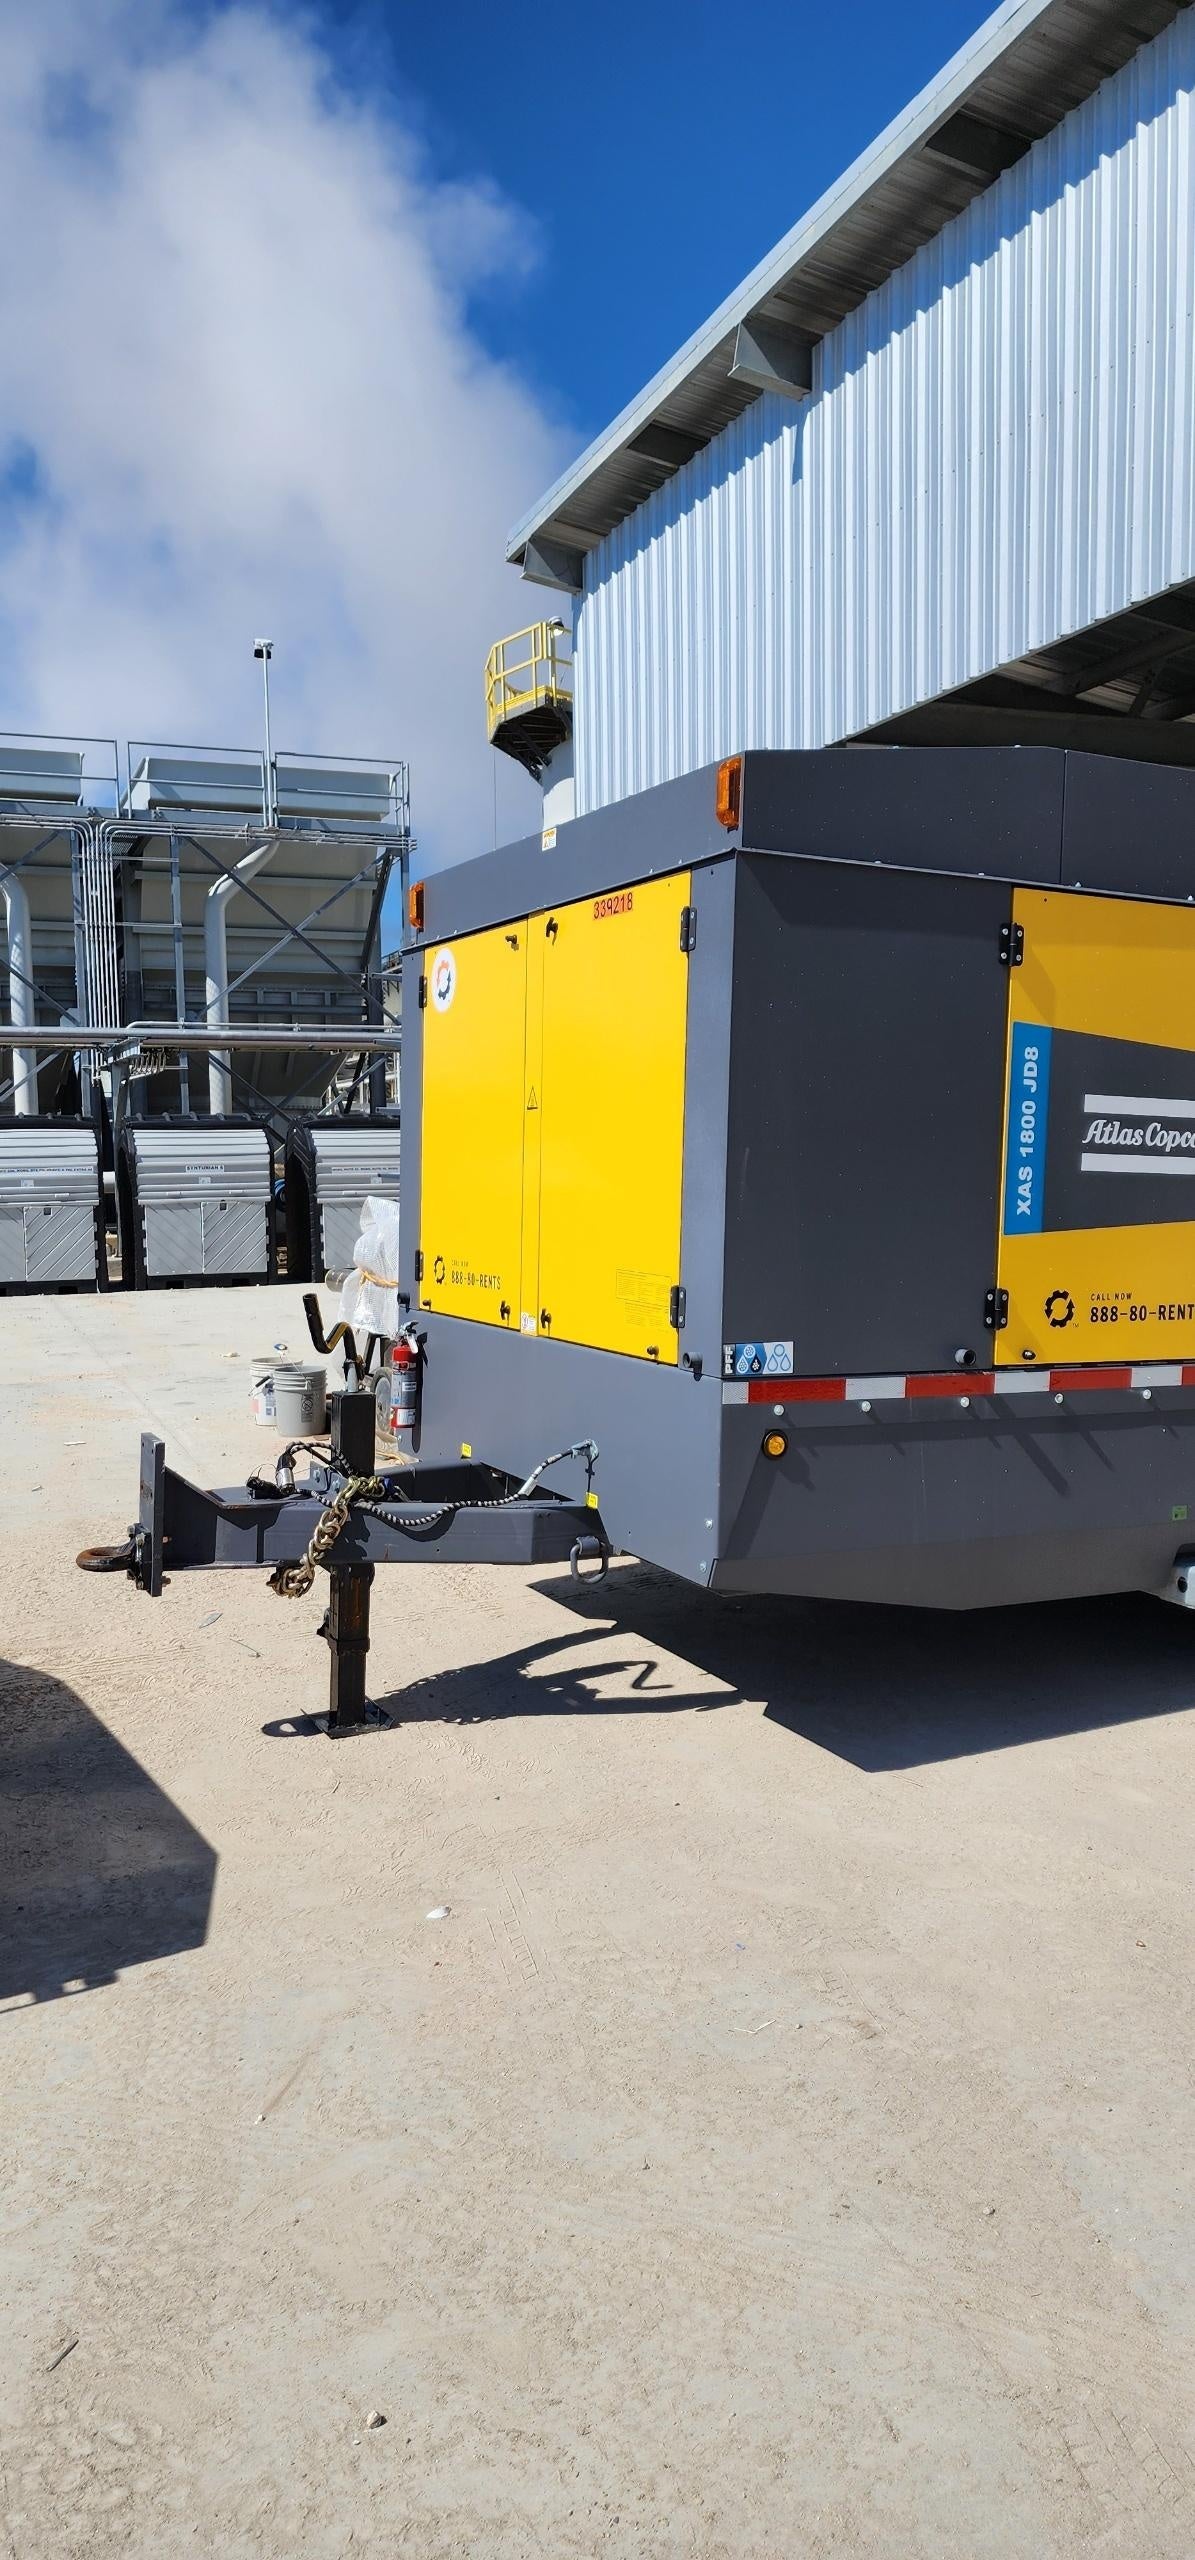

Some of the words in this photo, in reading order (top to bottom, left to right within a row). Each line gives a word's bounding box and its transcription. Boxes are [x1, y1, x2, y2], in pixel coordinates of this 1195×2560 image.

[593, 892, 633, 919] 339218
[1023, 1046, 1039, 1093] JD8
[1019, 1100, 1037, 1158] 1800
[1081, 1119, 1144, 1146] Atlas
[1016, 1166, 1033, 1216] XAS
[1090, 1293, 1111, 1301] CALL
[1114, 1292, 1133, 1300] NOW
[1090, 1304, 1195, 1323] 888-80-RENT
[724, 1346, 733, 1374] PFF
